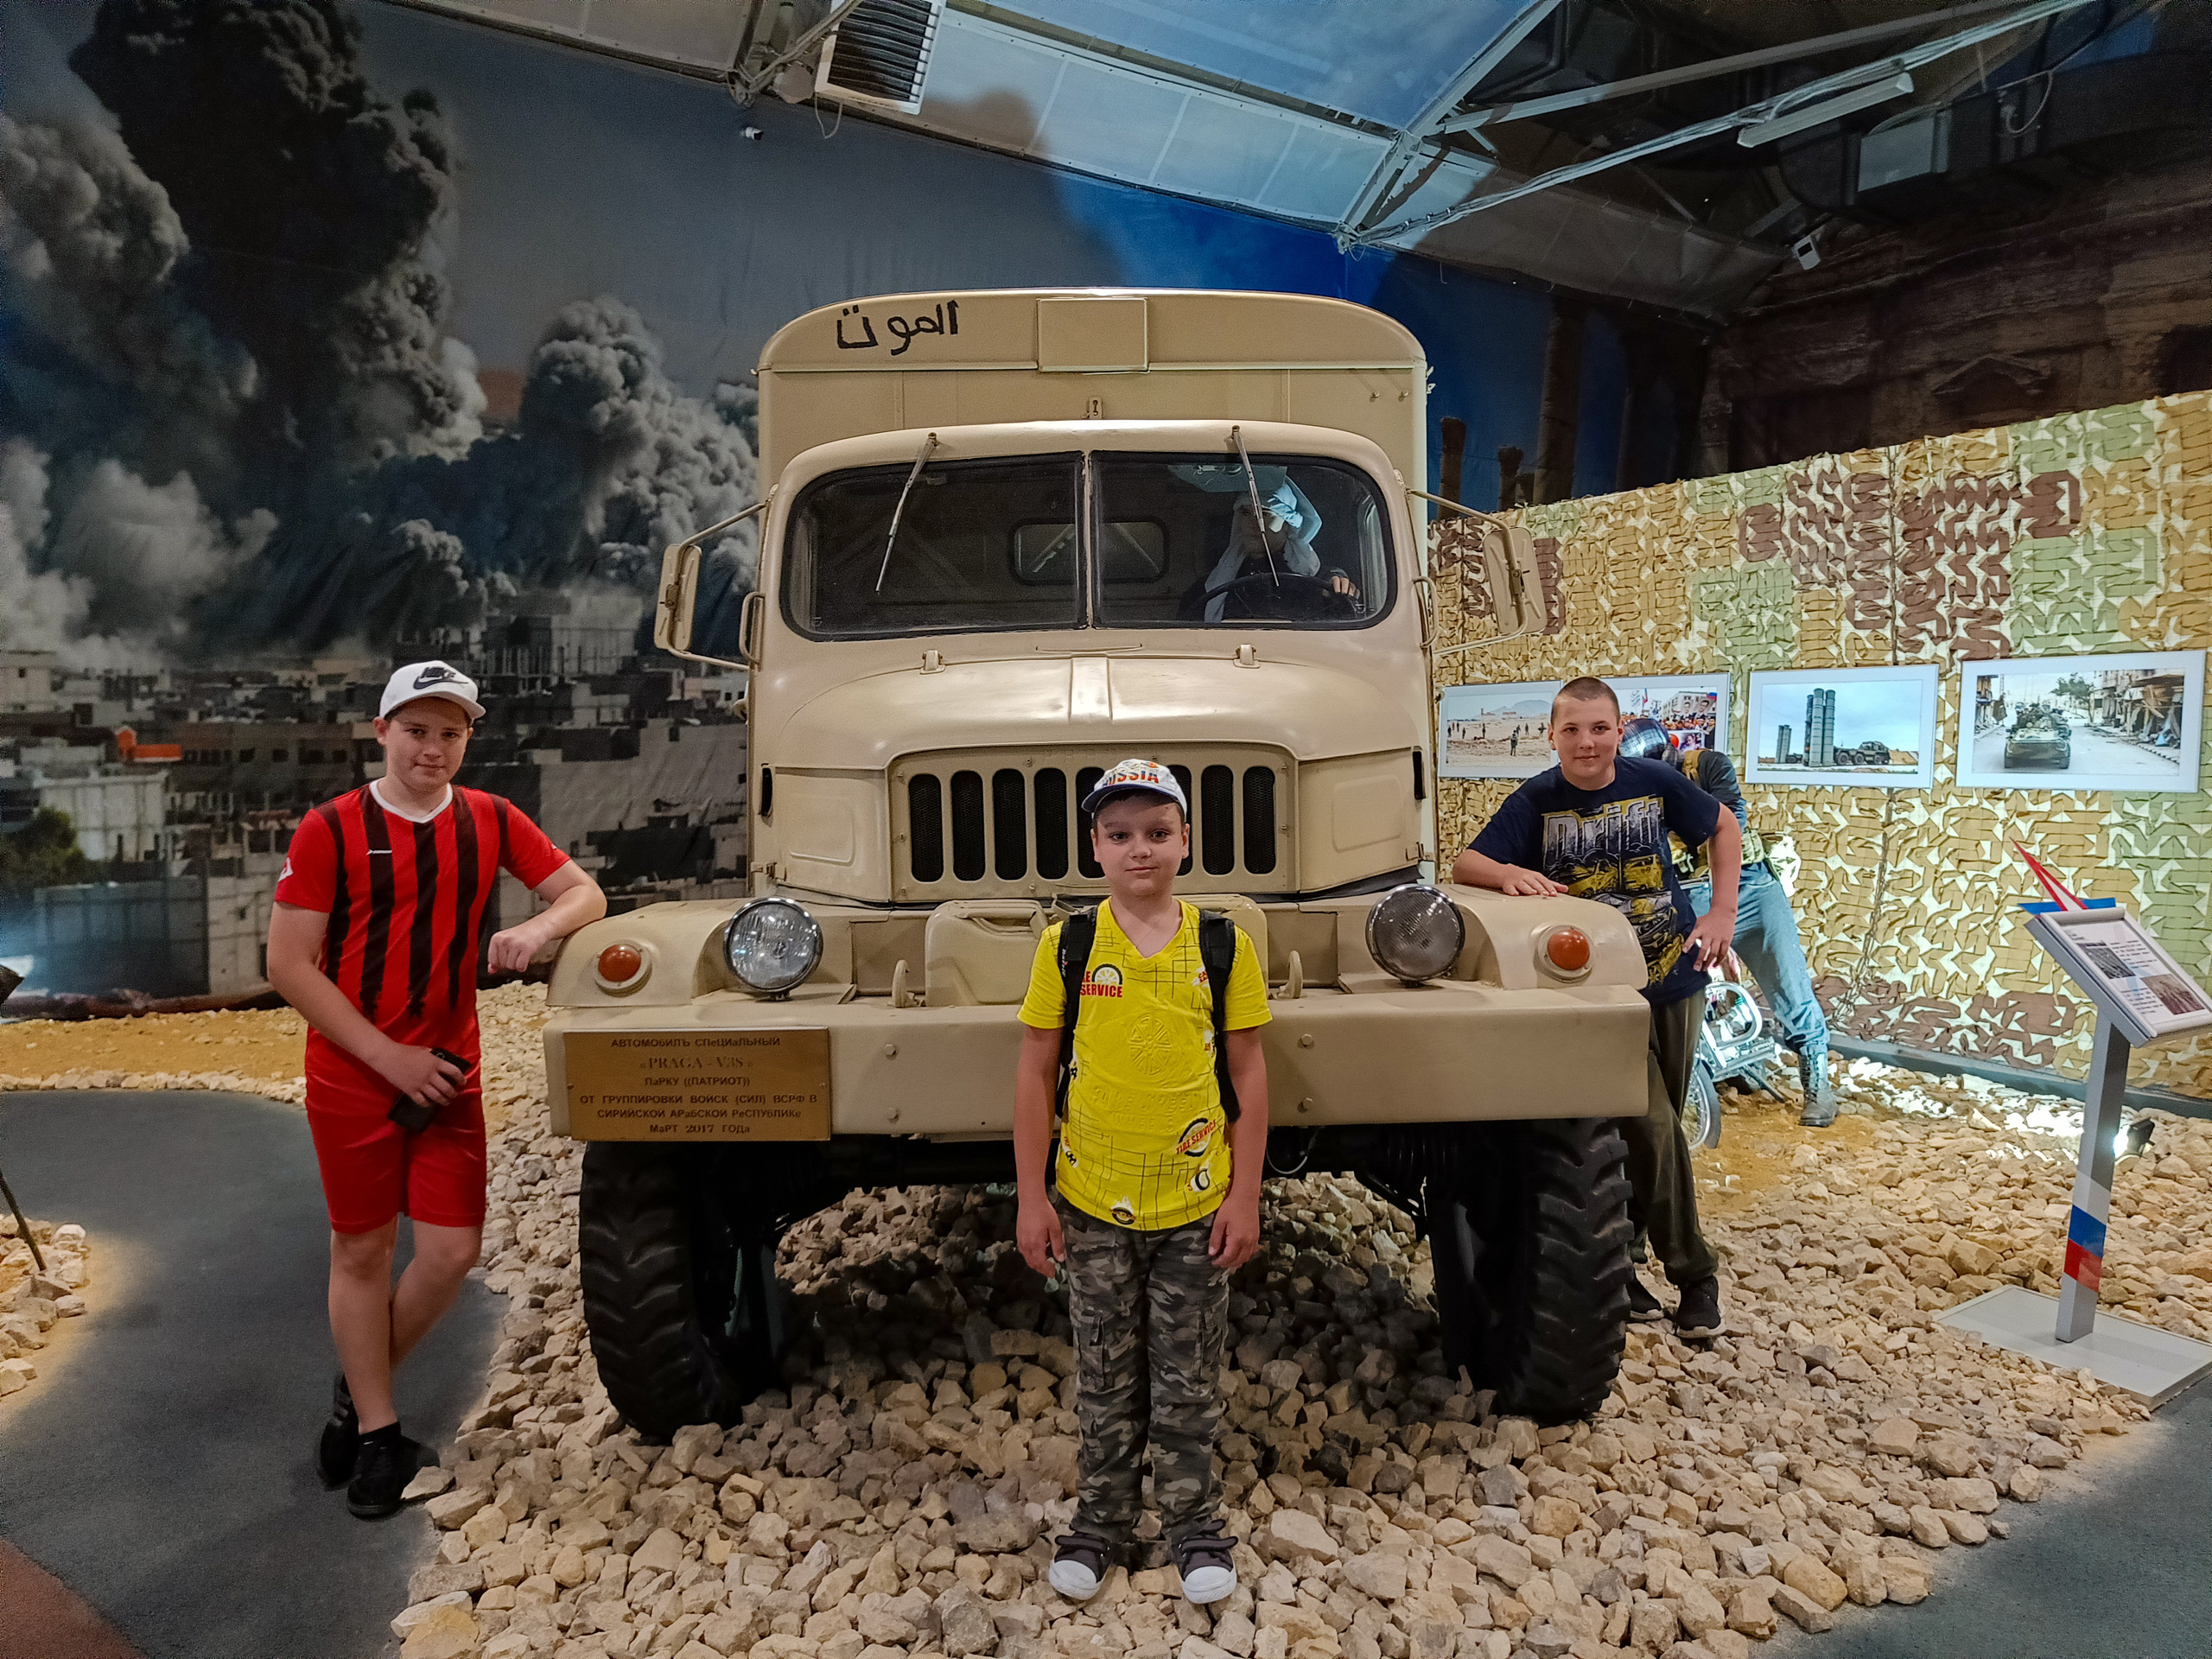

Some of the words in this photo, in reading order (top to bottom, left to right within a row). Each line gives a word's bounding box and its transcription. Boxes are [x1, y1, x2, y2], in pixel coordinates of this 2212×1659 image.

[836, 300, 959, 356] الموت
[1543, 798, 1662, 867] Drift
[1080, 983, 1122, 998] SERVICE
[580, 1095, 594, 1104] ОТ
[773, 1094, 804, 1103] ВСРФ
[810, 1094, 817, 1103] В
[685, 1124, 715, 1134] 2017
